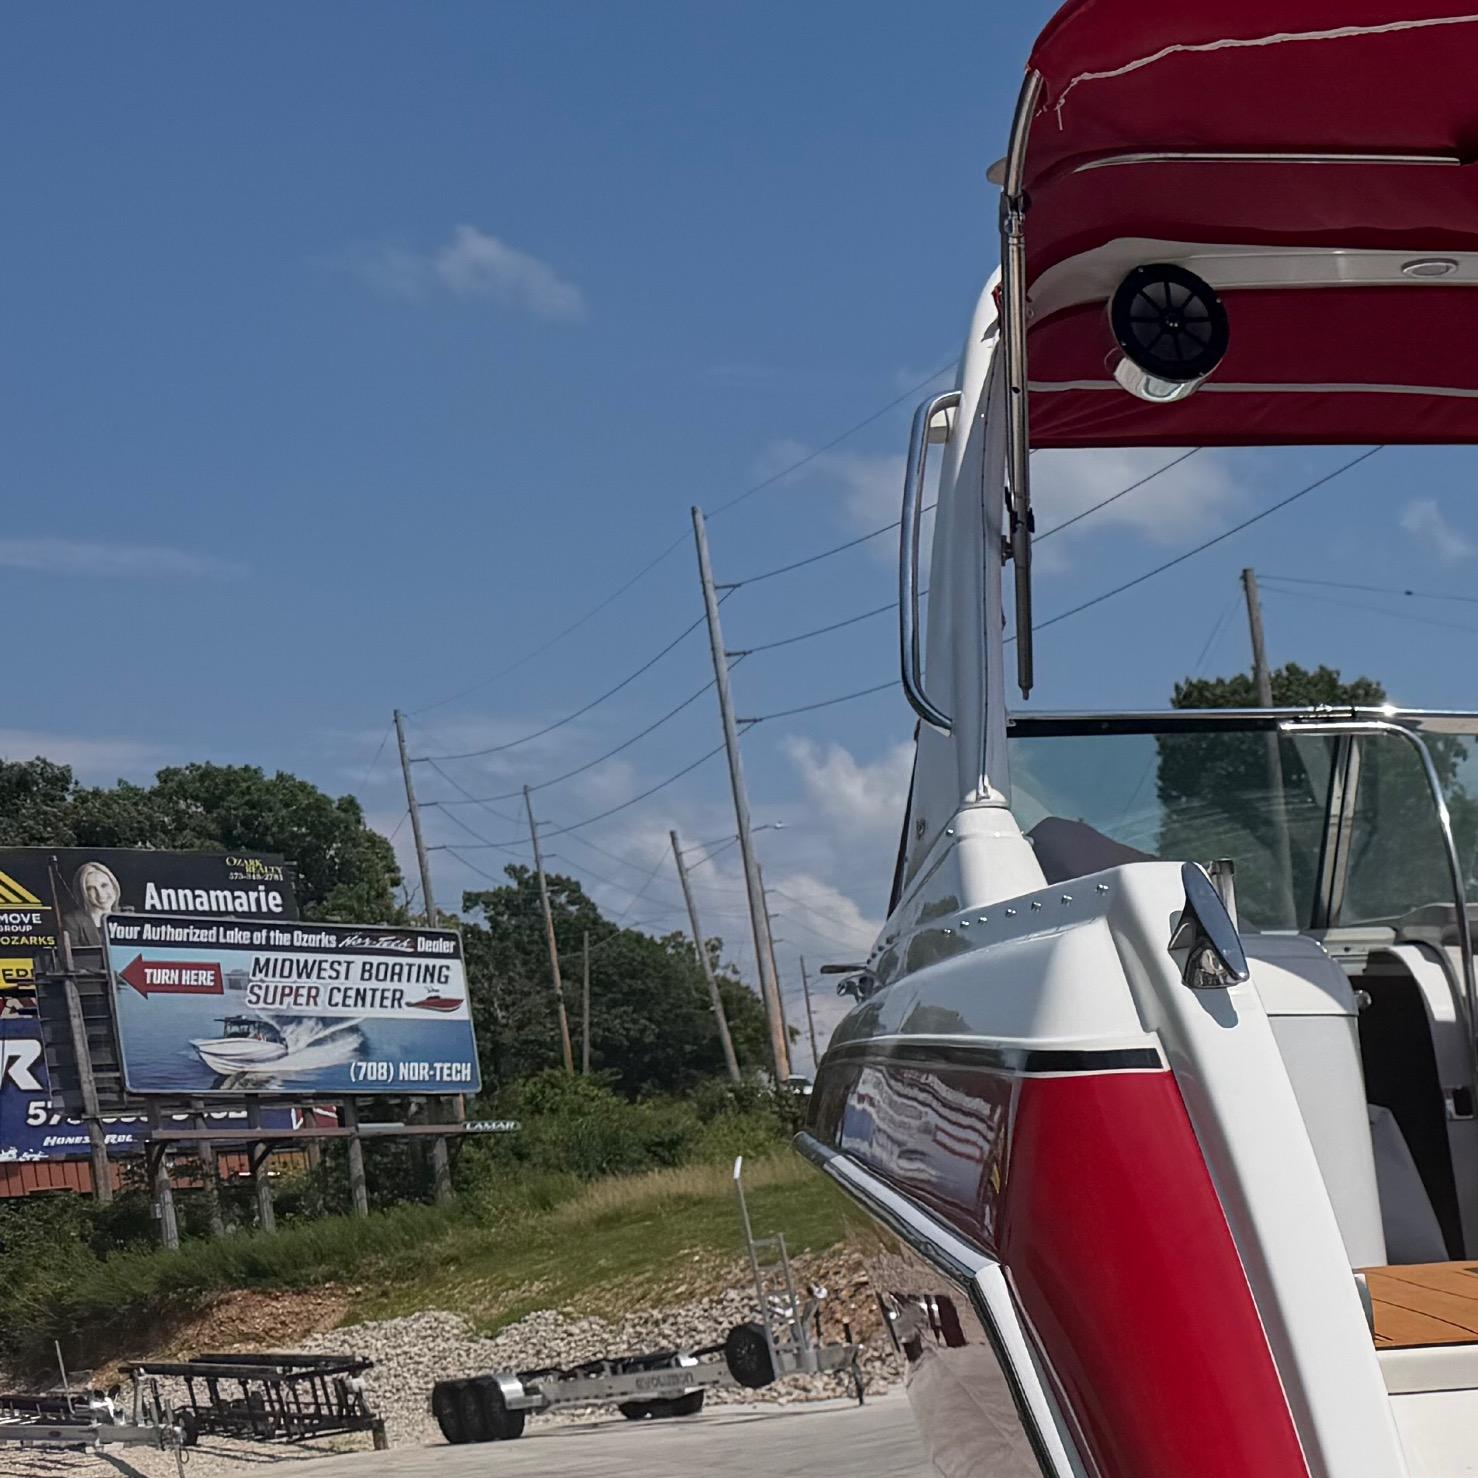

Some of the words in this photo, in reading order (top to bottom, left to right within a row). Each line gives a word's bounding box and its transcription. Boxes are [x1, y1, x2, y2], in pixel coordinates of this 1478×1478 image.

[144, 882, 283, 913] Annamarie
[109, 922, 141, 939] Your
[143, 924, 217, 943] Authorized
[219, 927, 250, 943] Lake
[253, 929, 268, 945] of
[269, 930, 292, 946] the
[294, 931, 337, 948] Ozarks
[417, 936, 456, 953] Dealer
[144, 968, 179, 985] TURN
[182, 969, 215, 986] HERE
[251, 957, 355, 981] MIDWEST
[360, 961, 450, 985] BOATING
[248, 984, 320, 1007] SUPER
[328, 986, 404, 1008] CENTER
[350, 1061, 394, 1082] (708)
[399, 1062, 471, 1082] NOR-TECH
[466, 1121, 515, 1131] LAMAR
